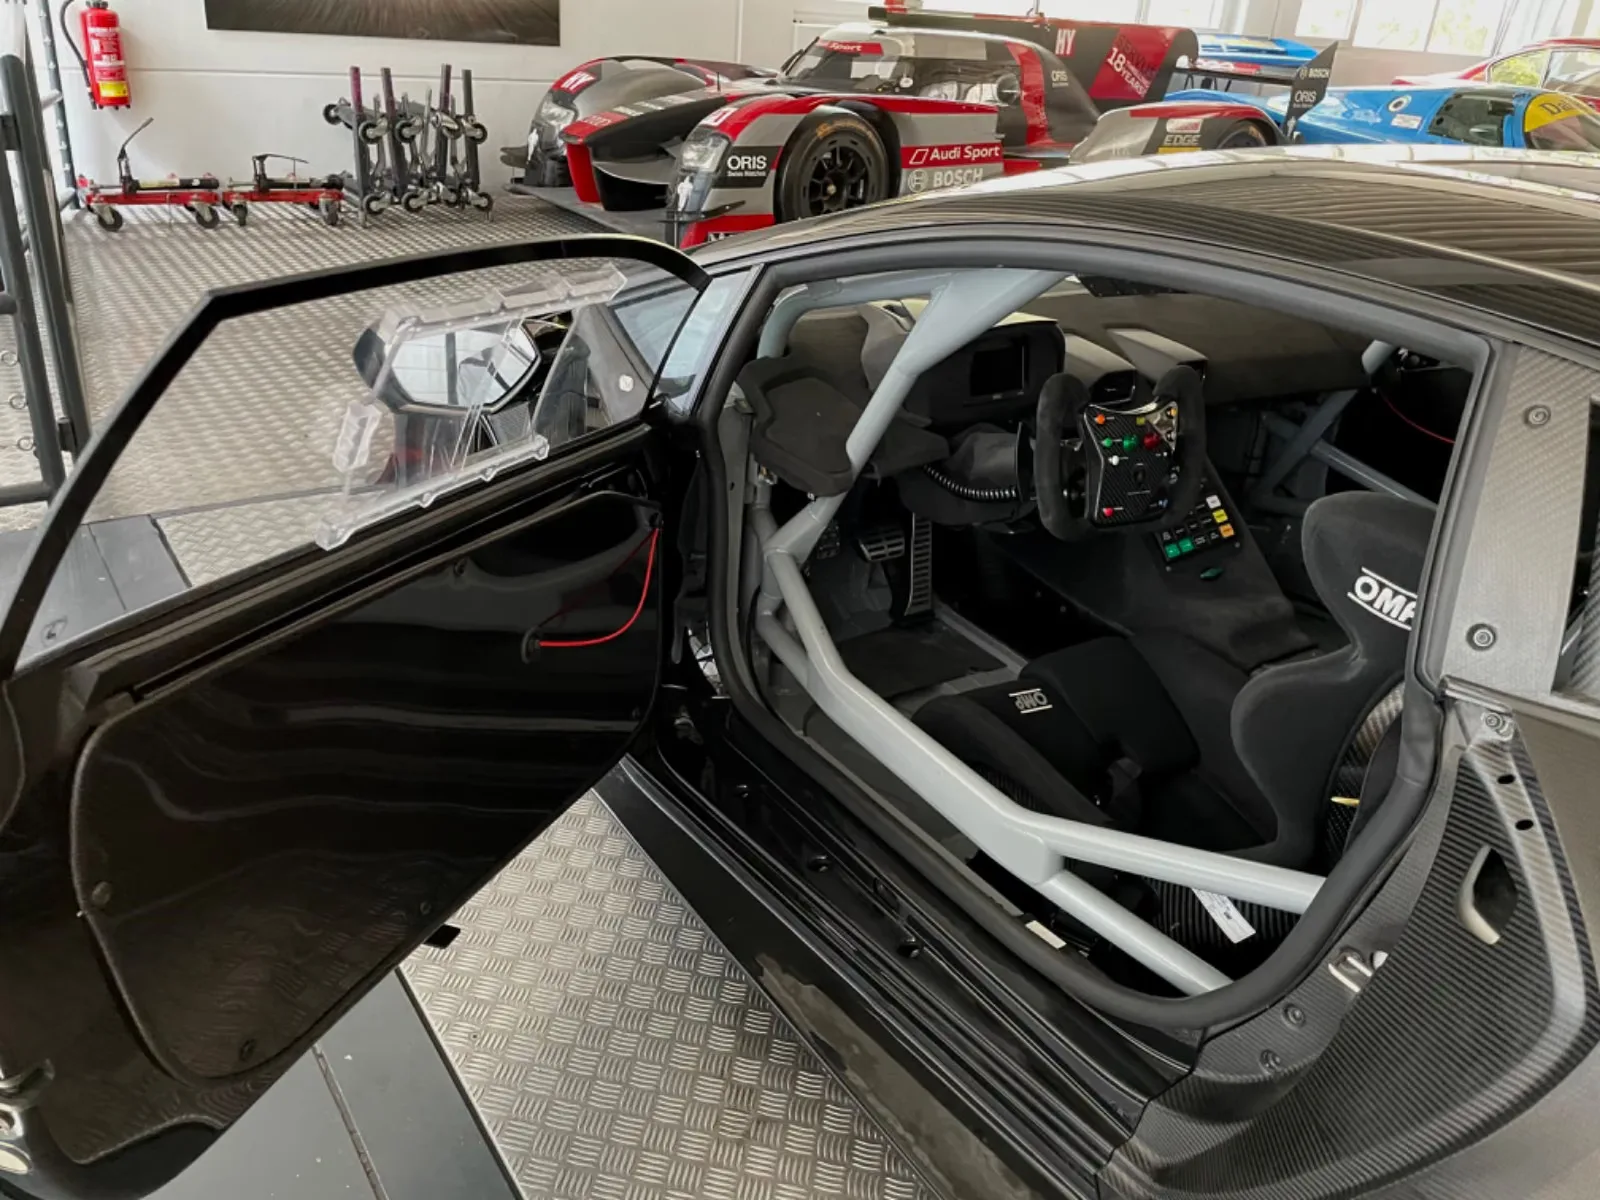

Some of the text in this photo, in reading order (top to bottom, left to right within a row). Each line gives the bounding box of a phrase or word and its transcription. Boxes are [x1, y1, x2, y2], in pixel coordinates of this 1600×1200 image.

[1107, 47, 1126, 73] 18
[1163, 134, 1202, 146] EDGE
[930, 145, 1000, 161] Audi Sport
[727, 155, 768, 170] ORIS
[933, 168, 983, 188] BOSCH
